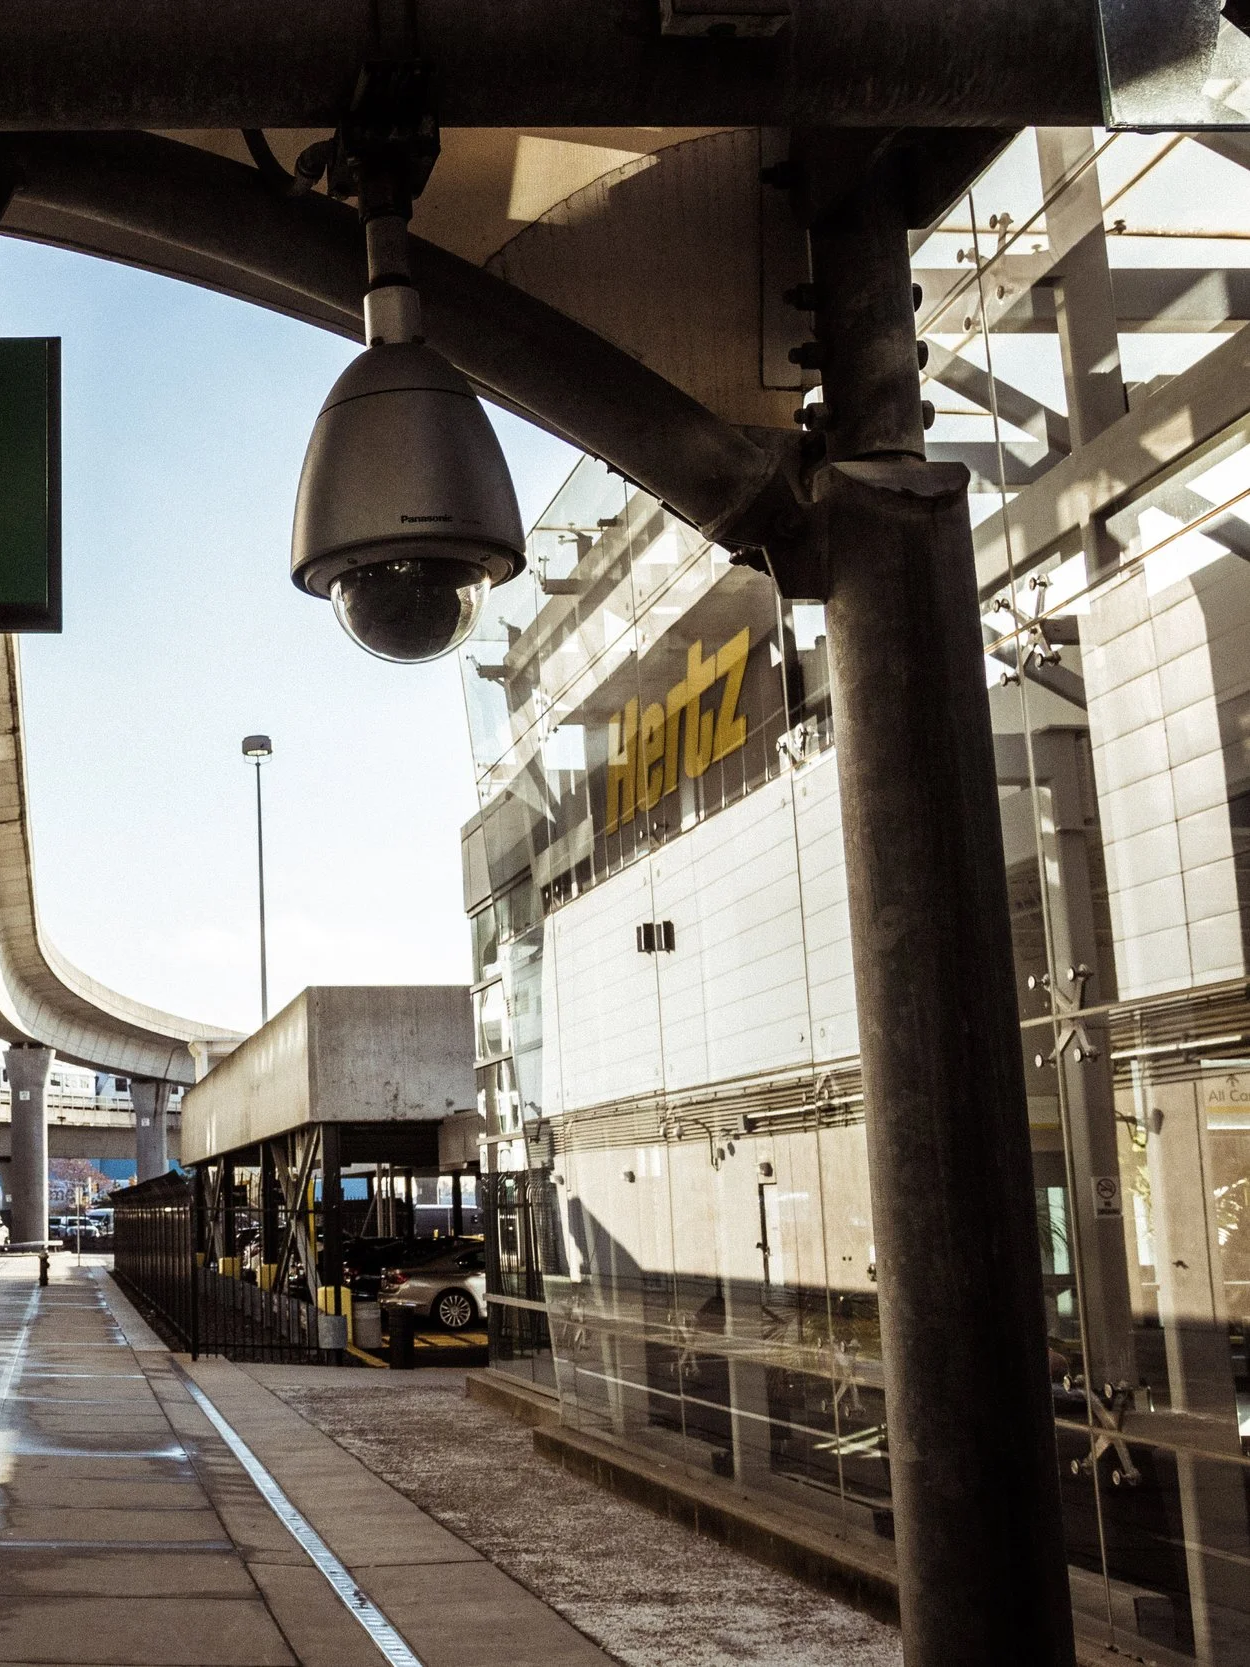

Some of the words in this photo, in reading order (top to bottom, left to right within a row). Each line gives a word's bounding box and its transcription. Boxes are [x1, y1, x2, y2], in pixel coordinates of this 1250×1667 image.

[401, 514, 453, 524] Panasonic
[605, 625, 750, 837] Hertz
[1209, 1090, 1225, 1102] All
[1230, 1089, 1250, 1102] Ca
